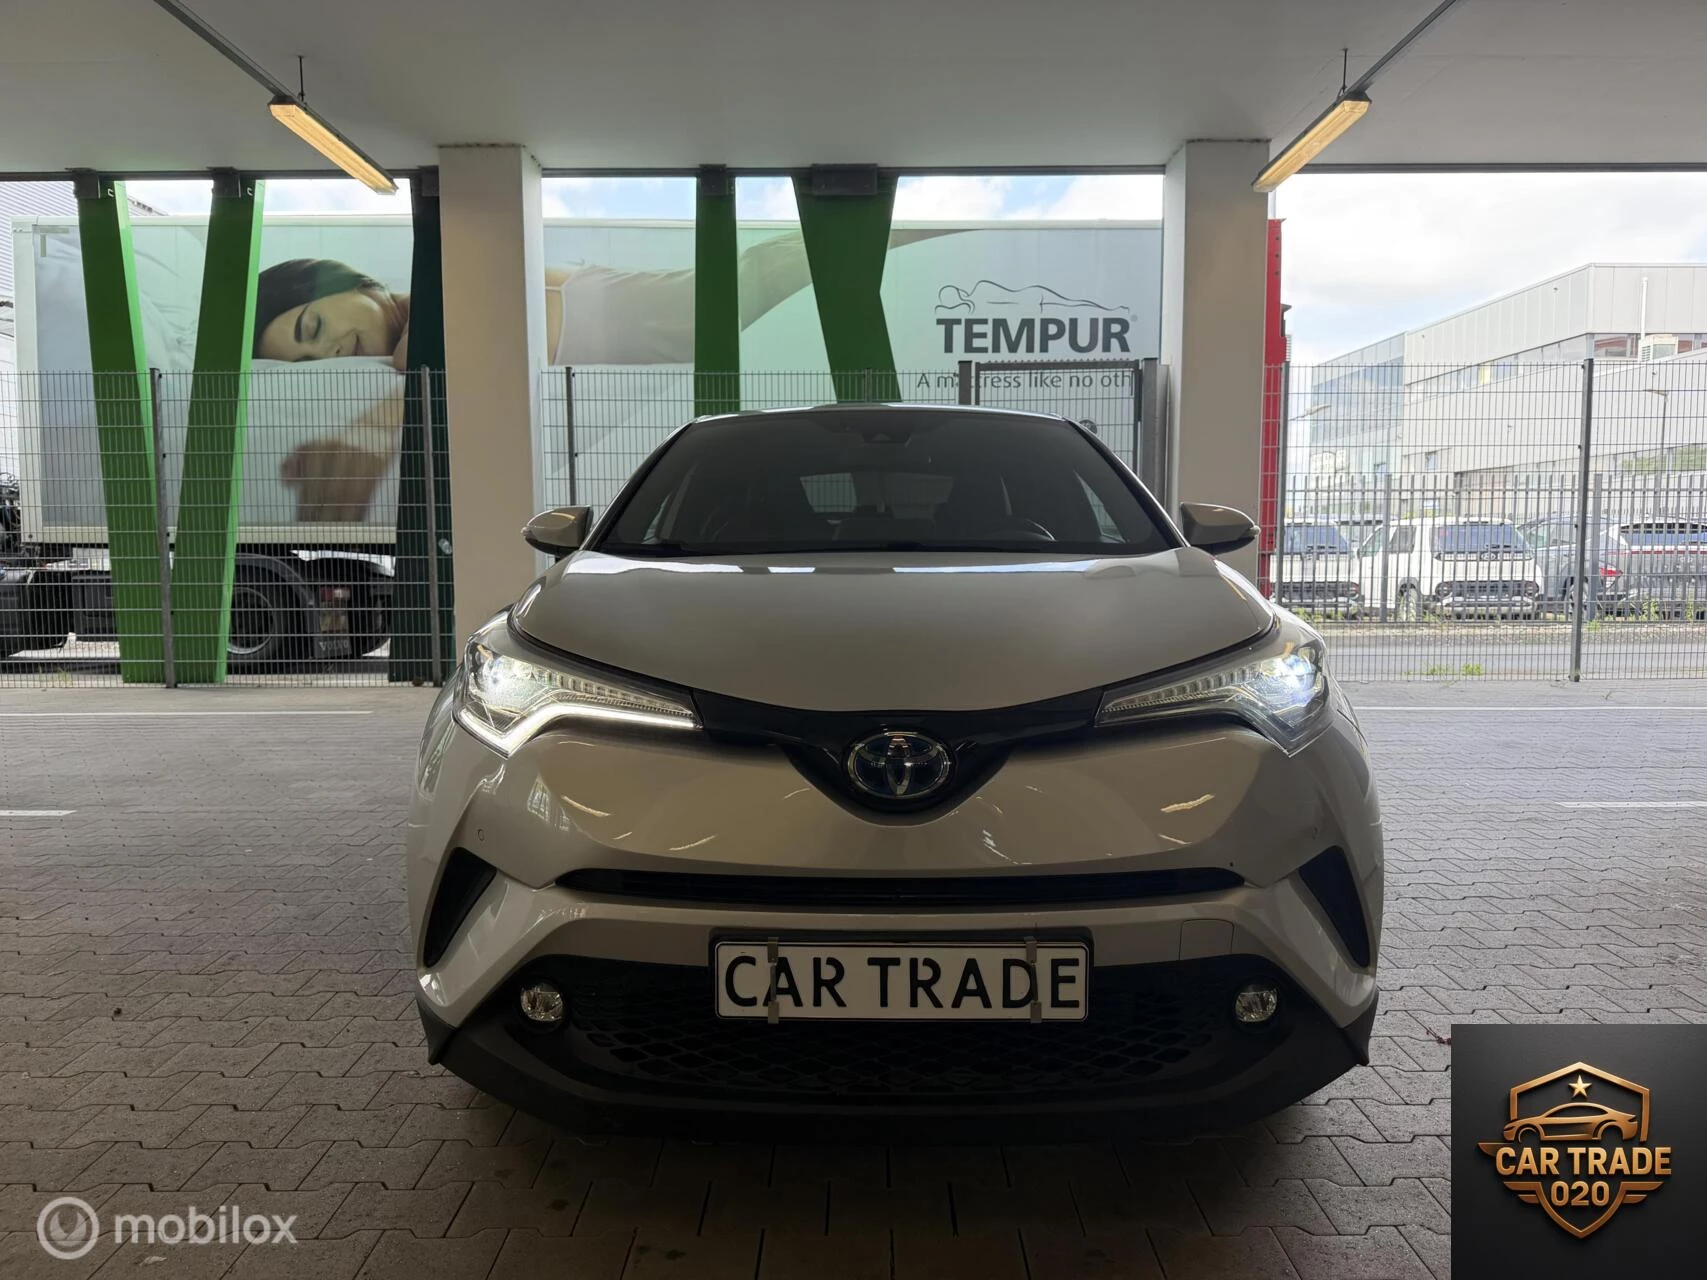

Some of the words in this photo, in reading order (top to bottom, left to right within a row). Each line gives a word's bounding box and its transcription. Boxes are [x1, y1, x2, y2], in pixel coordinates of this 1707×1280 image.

[935, 318, 1131, 353] TEMPUR
[917, 373, 930, 388] A
[937, 374, 1021, 388] mress
[1028, 371, 1062, 388] like
[1069, 374, 1093, 388] no
[1100, 371, 1132, 388] oth
[724, 955, 848, 1008] CAR
[866, 957, 1081, 1009] TRADE
